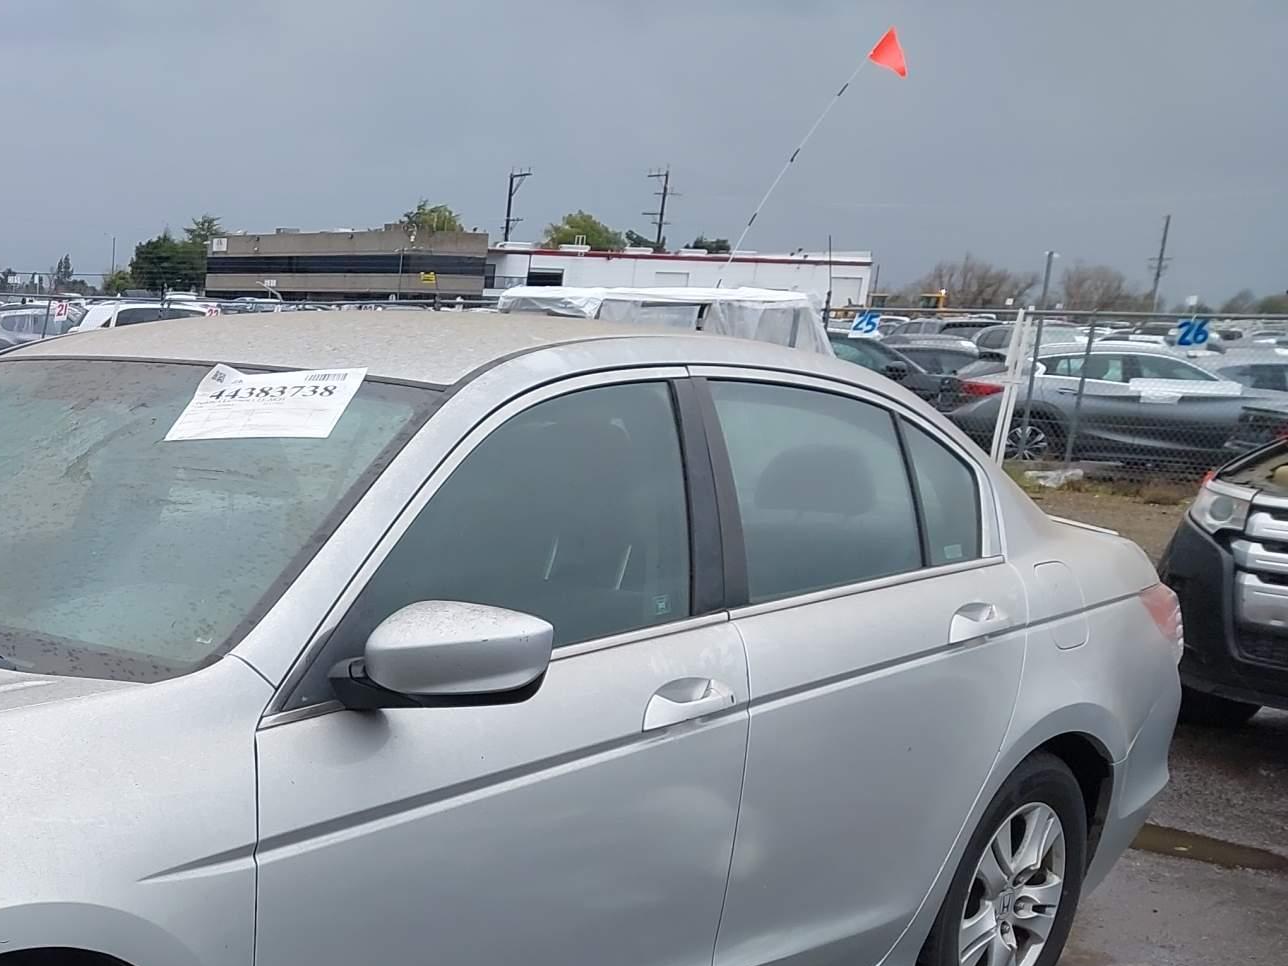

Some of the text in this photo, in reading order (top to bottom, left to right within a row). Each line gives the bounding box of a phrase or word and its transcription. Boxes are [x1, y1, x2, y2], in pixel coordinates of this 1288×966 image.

[56, 304, 67, 316] 21
[853, 313, 880, 333] 25
[1177, 320, 1209, 346] 26
[209, 384, 337, 400] 44383738
